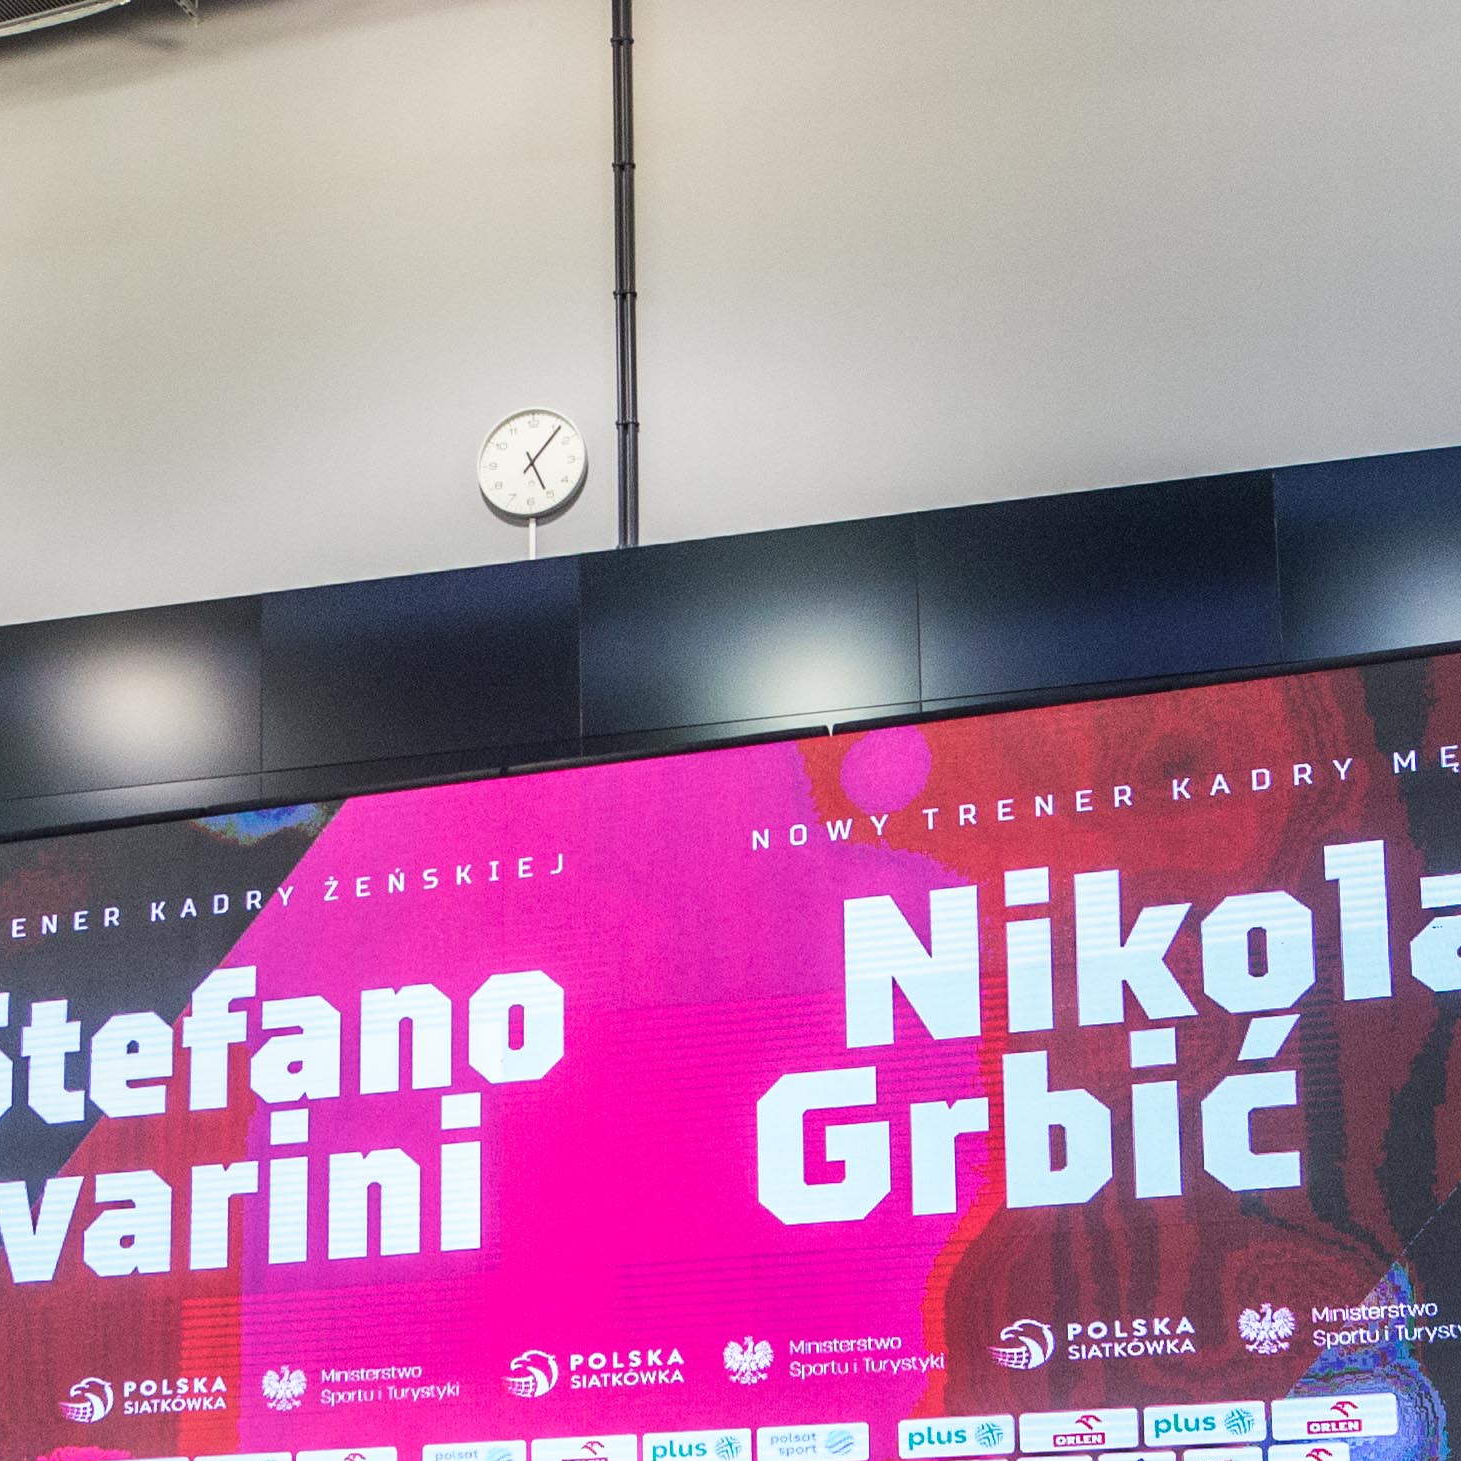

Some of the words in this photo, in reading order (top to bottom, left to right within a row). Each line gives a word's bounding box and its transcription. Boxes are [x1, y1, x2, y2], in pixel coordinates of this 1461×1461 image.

[752, 814, 890, 851] NOWY
[923, 784, 1133, 830] TRENER
[1172, 758, 1354, 800] KADRY
[150, 886, 295, 922] KADRY
[324, 852, 566, 901] ŻEŃSKIEJ
[756, 1014, 1301, 1226] Grbić
[1312, 1301, 1437, 1322] Ministerstwo
[1067, 1317, 1195, 1340] POLSKA
[1313, 1326, 1379, 1349] Sportu
[790, 1335, 902, 1353] Ministerstwo
[1068, 1337, 1195, 1360] SIATKÓWKA
[570, 1348, 684, 1371] POLSKA
[790, 1359, 848, 1380] Sportu
[864, 1353, 945, 1376] Turystyki
[321, 1365, 422, 1382] Ministerstwo
[571, 1368, 684, 1389] SIATKÓWKA
[123, 1376, 228, 1396] POLSKA
[321, 1388, 373, 1406] Sportu
[387, 1383, 459, 1403] Turystyki
[124, 1394, 227, 1414] SIATKÓWKA
[1154, 1412, 1217, 1439] plus
[1307, 1420, 1361, 1433] ORLEN
[908, 1425, 967, 1450] plus
[1053, 1433, 1105, 1445] ORLEN
[652, 1439, 707, 1461] plus
